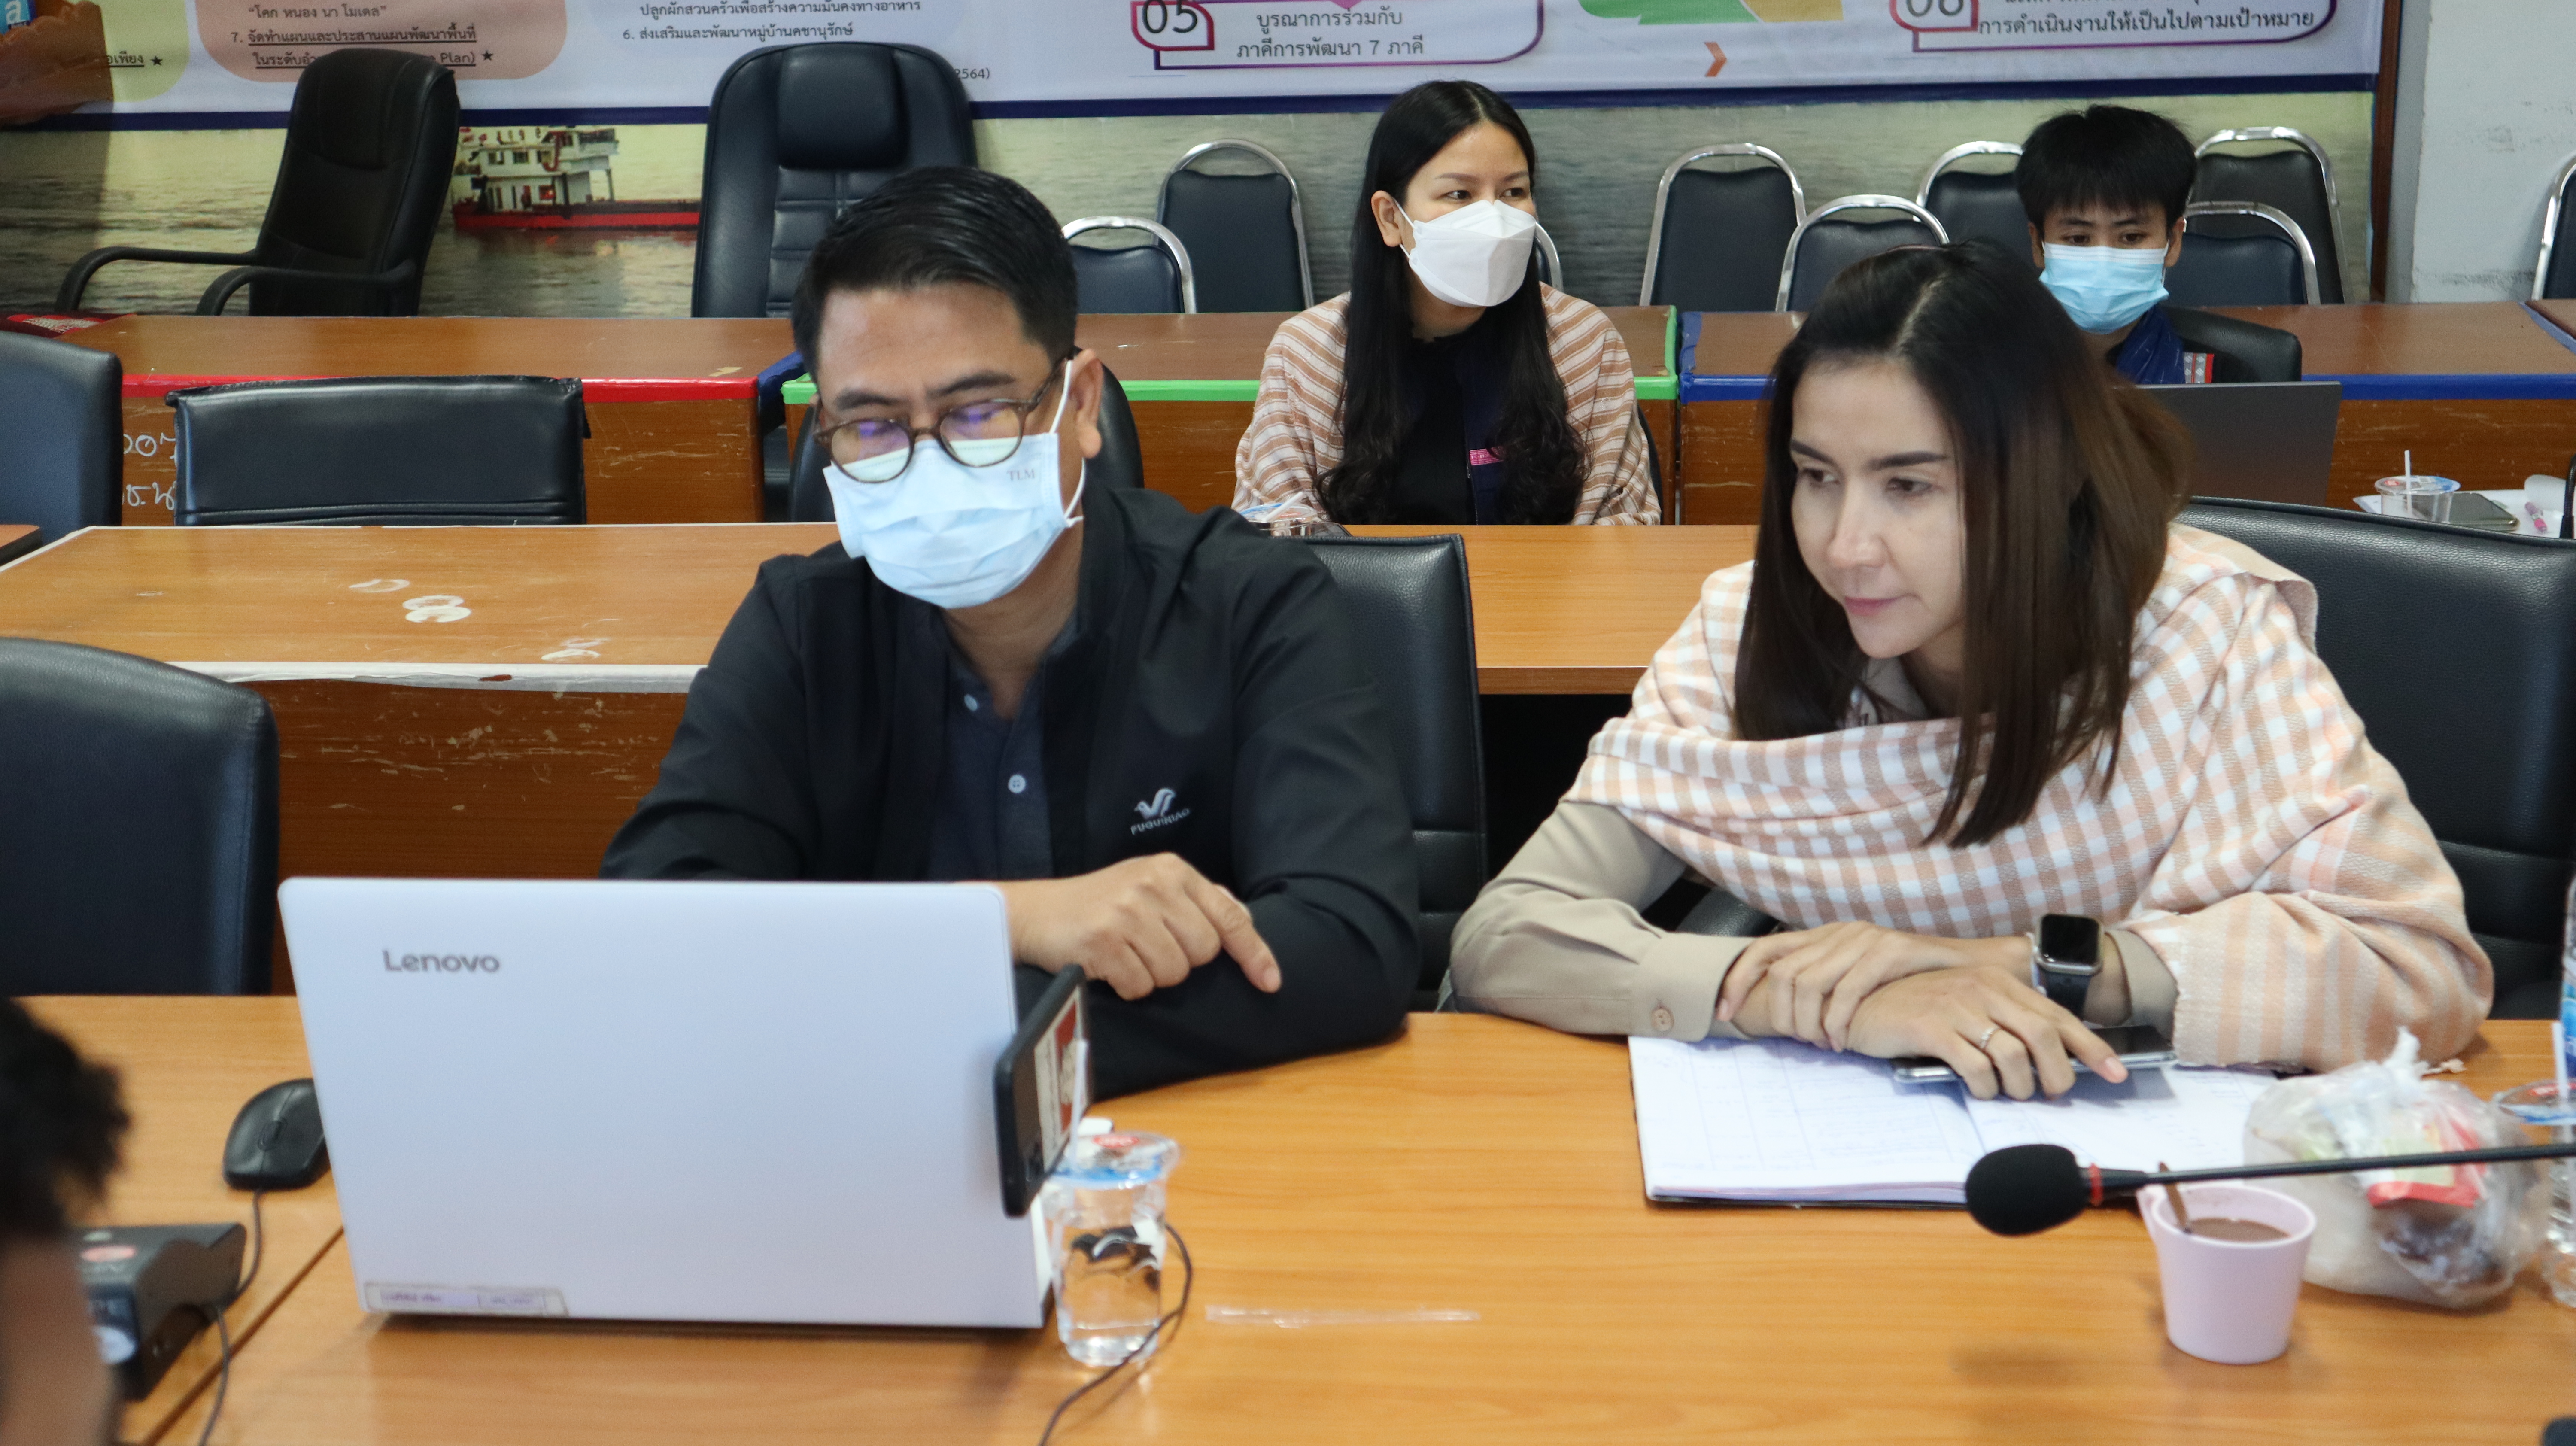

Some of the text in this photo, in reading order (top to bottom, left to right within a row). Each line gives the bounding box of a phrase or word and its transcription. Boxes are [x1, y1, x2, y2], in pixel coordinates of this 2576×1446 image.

[283, 8, 317, 18] หนอง
[322, 8, 339, 17] นา
[640, 0, 921, 20] ปลูกผักสวนครัวเพือสร้างความมันคงทางอาหาร
[1142, 0, 1197, 33] 05
[1256, 5, 1402, 34] บูรณาการร่วมกับ
[231, 32, 243, 43] 7.
[623, 29, 634, 39] 6.
[1237, 34, 1423, 57] ภาคีการพัฒนา 7 ภาคี
[440, 52, 475, 63] Plan)
[382, 947, 500, 973] Lenovo
